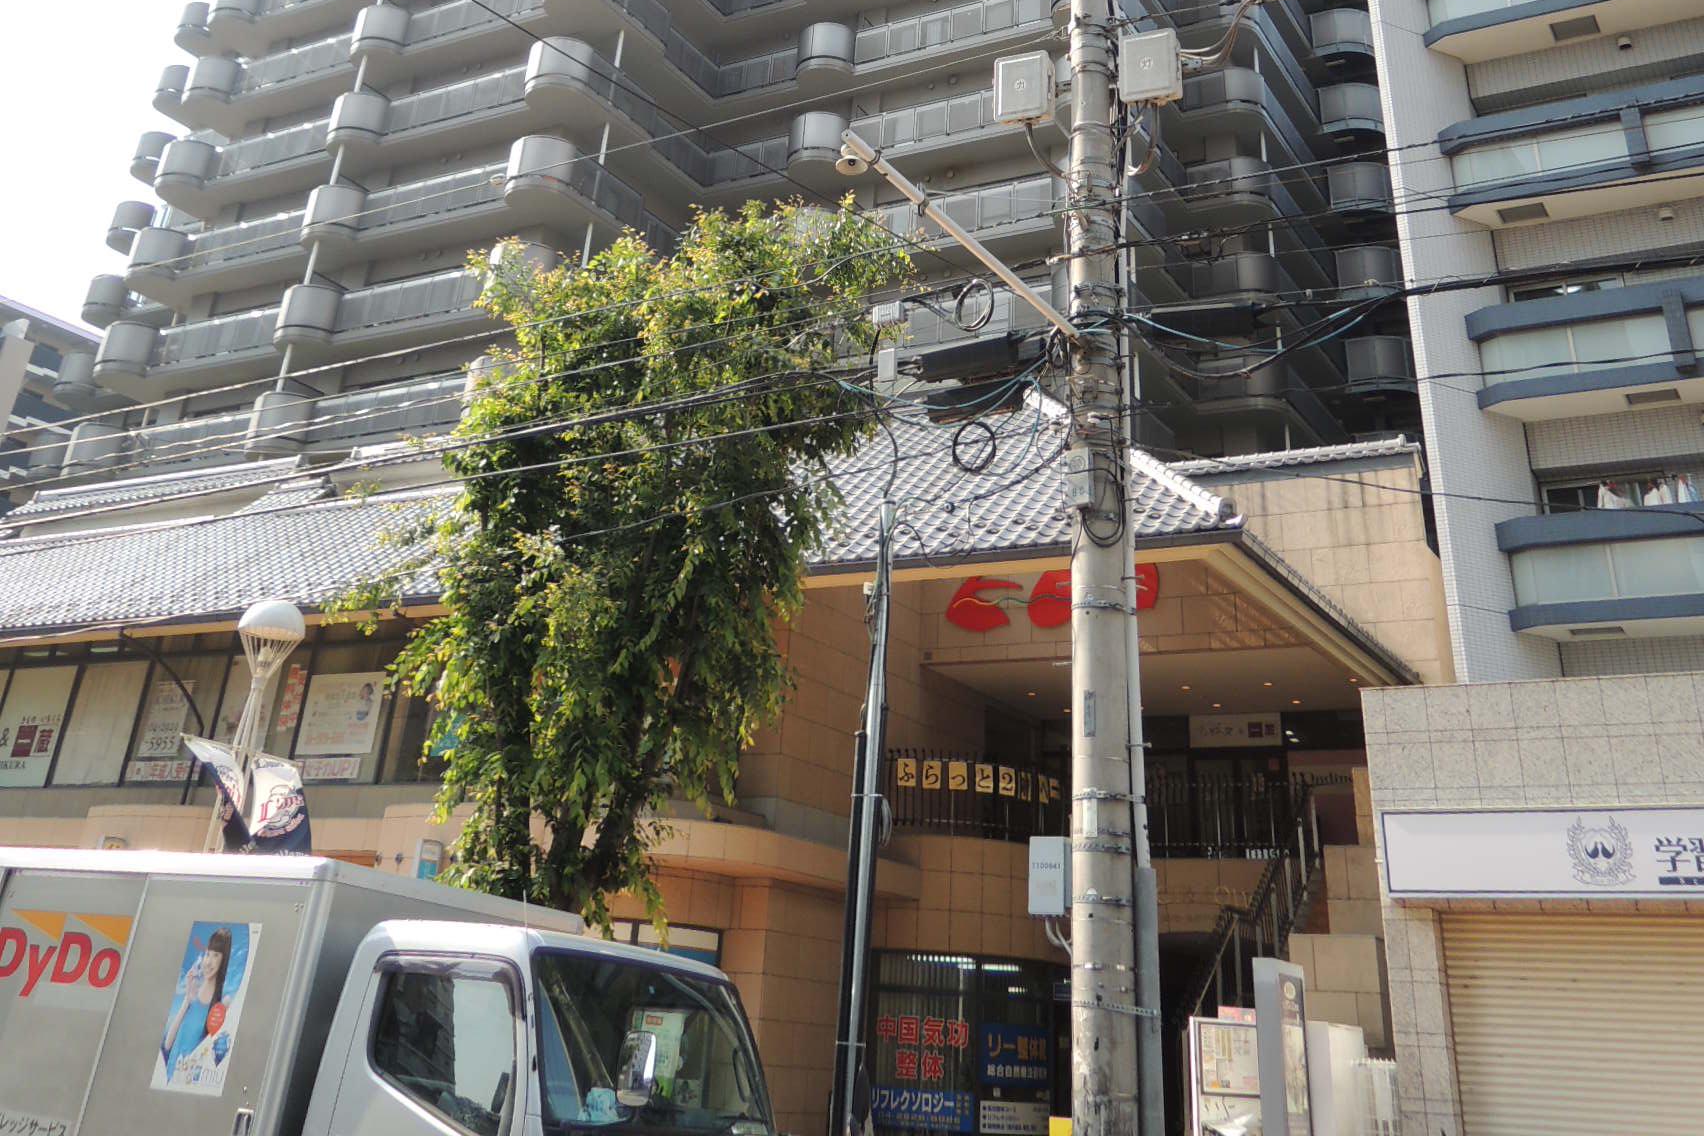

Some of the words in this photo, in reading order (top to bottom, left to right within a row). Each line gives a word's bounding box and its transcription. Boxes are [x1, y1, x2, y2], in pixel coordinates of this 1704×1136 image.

[0, 927, 122, 997] DyDo
[877, 1016, 969, 1049] 中国気功
[895, 1050, 945, 1080] 整体
[871, 1087, 955, 1112] リフレクソロジー
